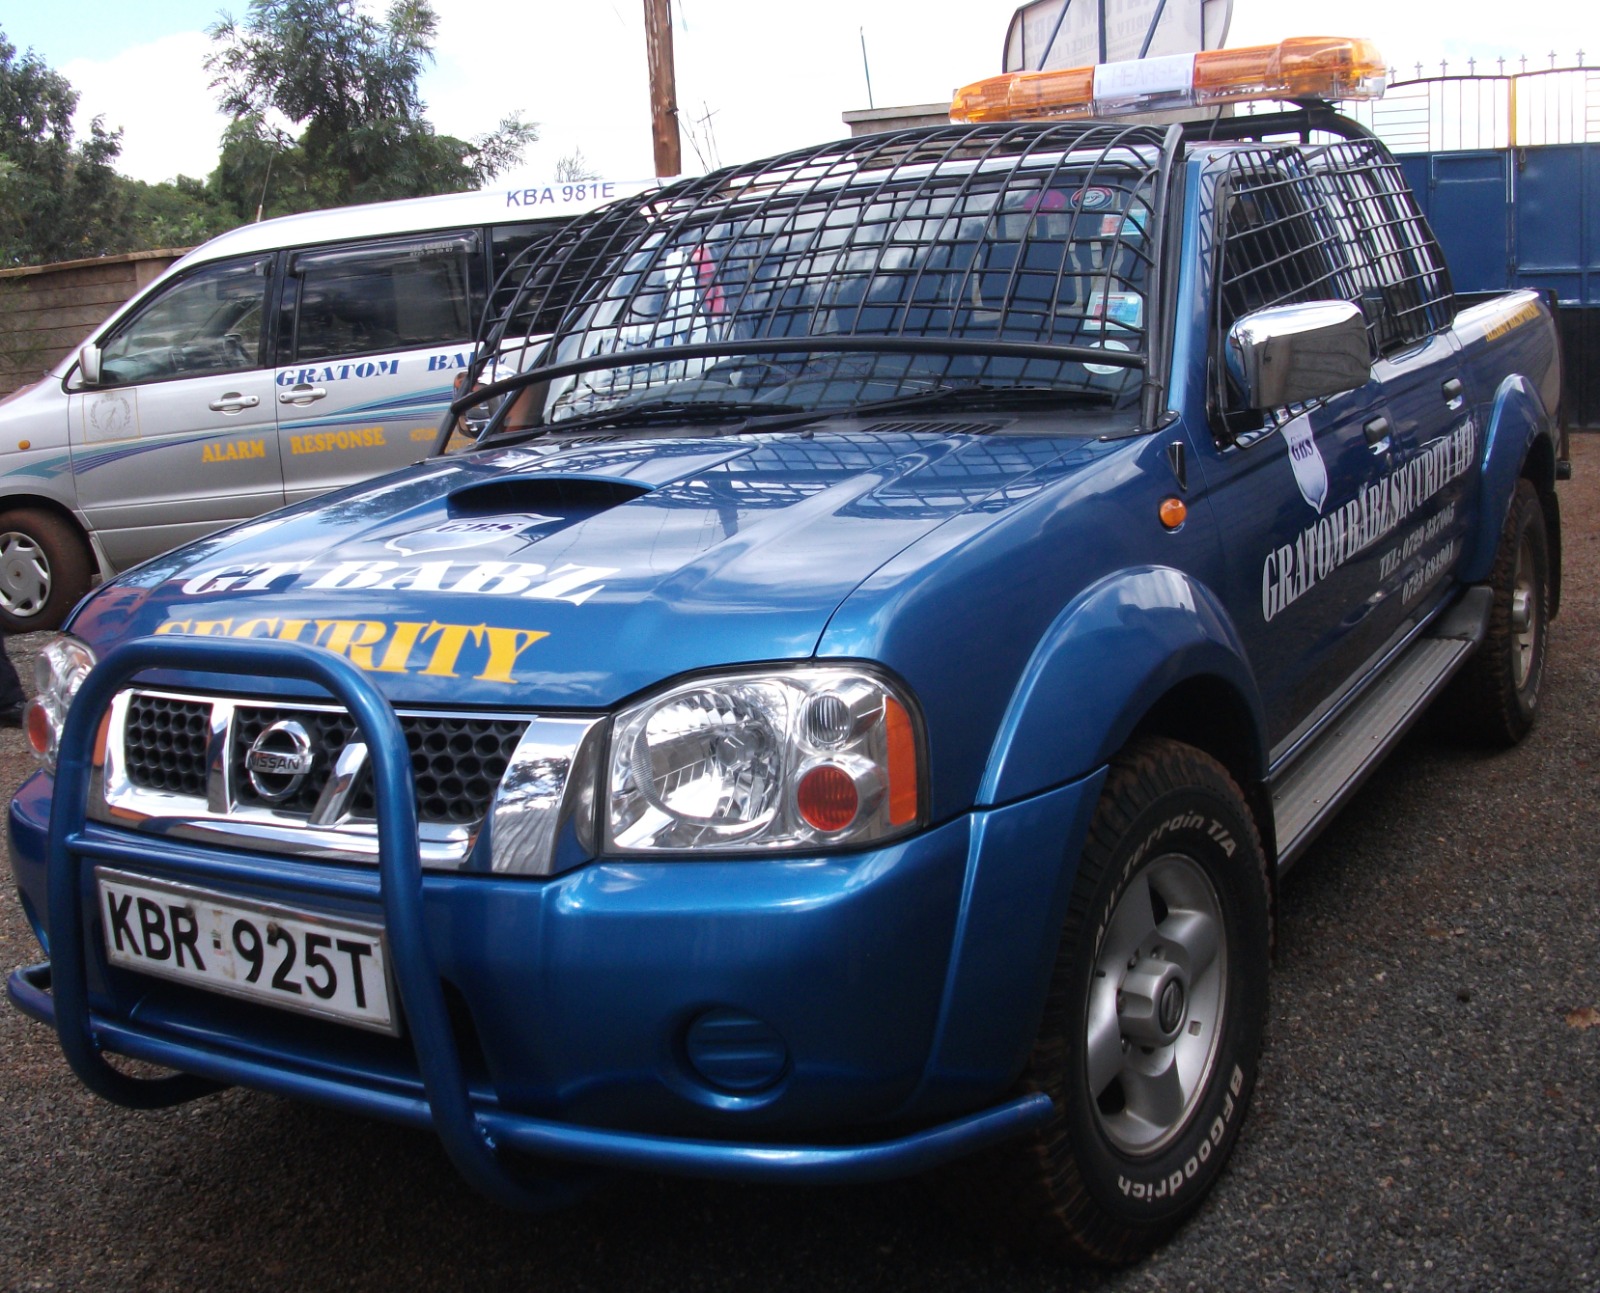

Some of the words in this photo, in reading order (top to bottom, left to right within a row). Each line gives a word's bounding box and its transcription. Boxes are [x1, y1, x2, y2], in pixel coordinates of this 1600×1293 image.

[507, 187, 555, 208] KBA
[562, 182, 615, 202] 981E
[276, 359, 400, 387] GRATOM
[202, 440, 265, 462] ALARM
[290, 427, 386, 455] RESPONSE
[1262, 507, 1345, 622] GRATOM
[1345, 476, 1392, 559] BABZ
[1390, 435, 1453, 528] SECURITY
[182, 559, 314, 595] GT
[304, 560, 620, 606] BABZ
[250, 752, 299, 771] NISSAN
[1207, 819, 1237, 858] T/A
[107, 892, 207, 971] KBR
[232, 919, 372, 1009] 925T
[1118, 1064, 1244, 1203] BFGoodrich
